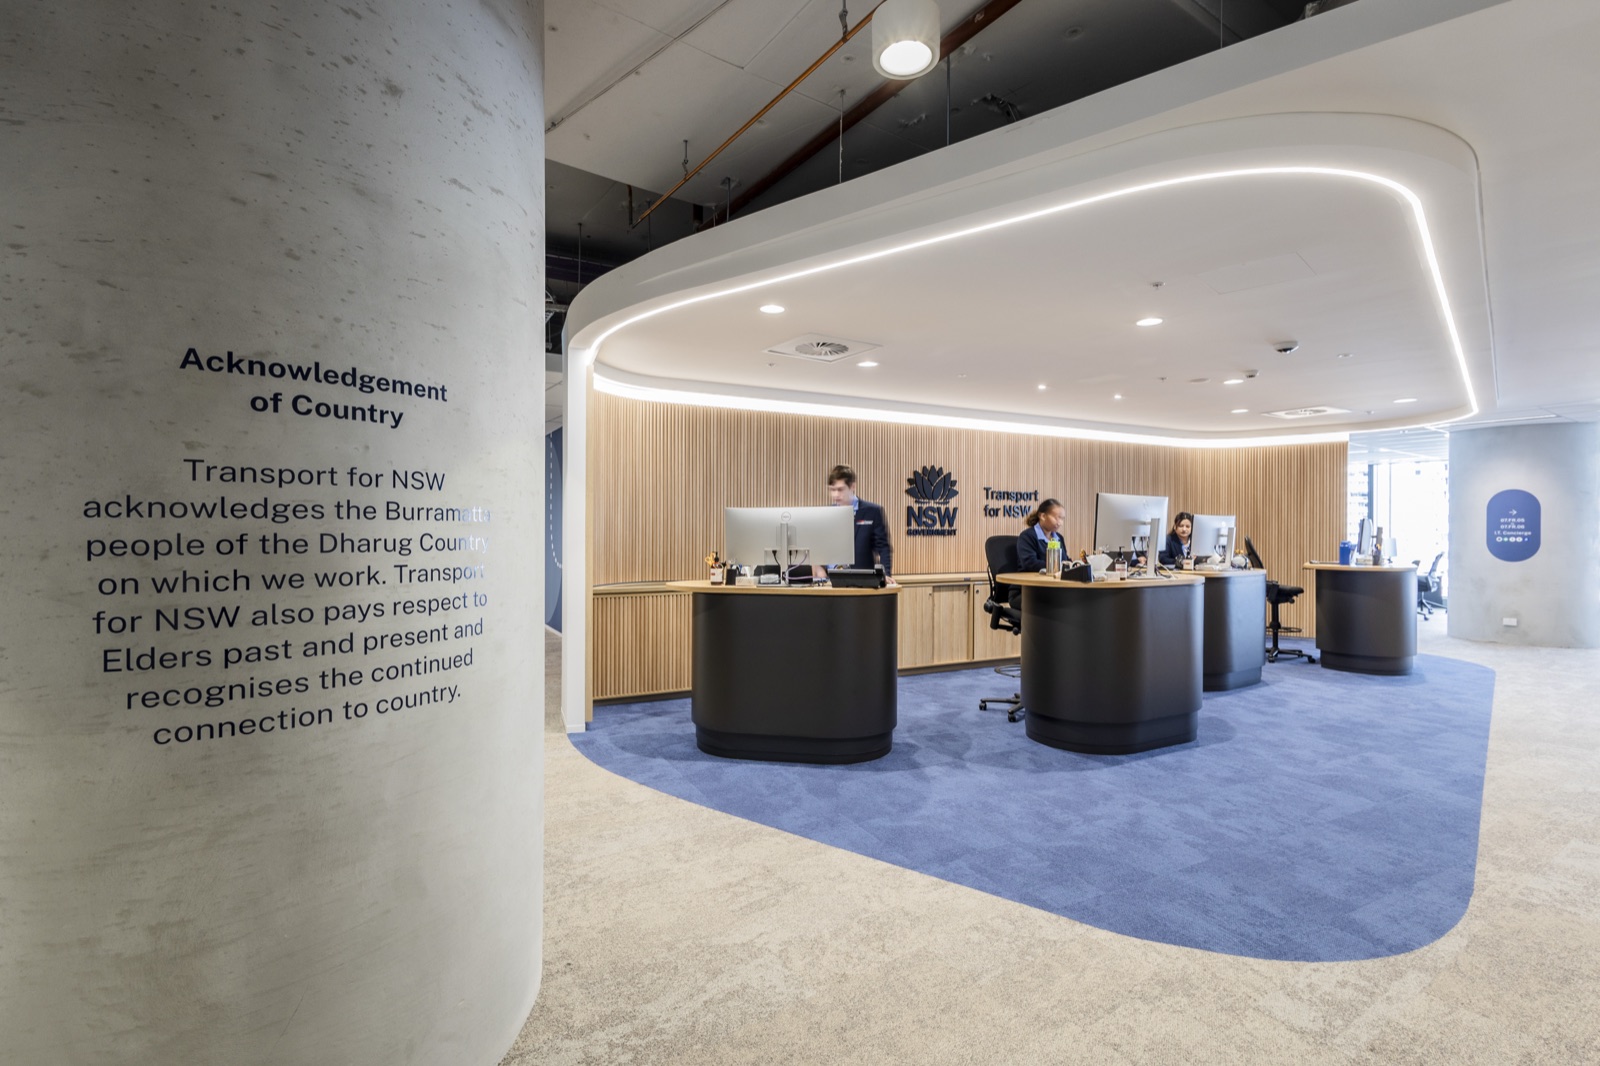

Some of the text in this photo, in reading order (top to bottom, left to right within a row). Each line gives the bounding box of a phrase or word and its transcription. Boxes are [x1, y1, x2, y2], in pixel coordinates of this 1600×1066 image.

[179, 348, 447, 402] Acknowledgement
[250, 392, 404, 429] of Country
[183, 459, 445, 491] Transport for NSW
[83, 494, 491, 524] acknowledges the Burramatta
[984, 487, 1039, 503] Transport
[907, 505, 958, 527] NSW
[984, 505, 1031, 518] for NSW
[87, 532, 489, 561] people of the Dharug Country
[98, 563, 485, 595] on which we work. Transport
[92, 592, 487, 634] for NSW also pays respect to
[103, 617, 483, 672] Elders past and present and
[127, 647, 472, 711] recognises the continued
[153, 685, 460, 745] connection to country.
